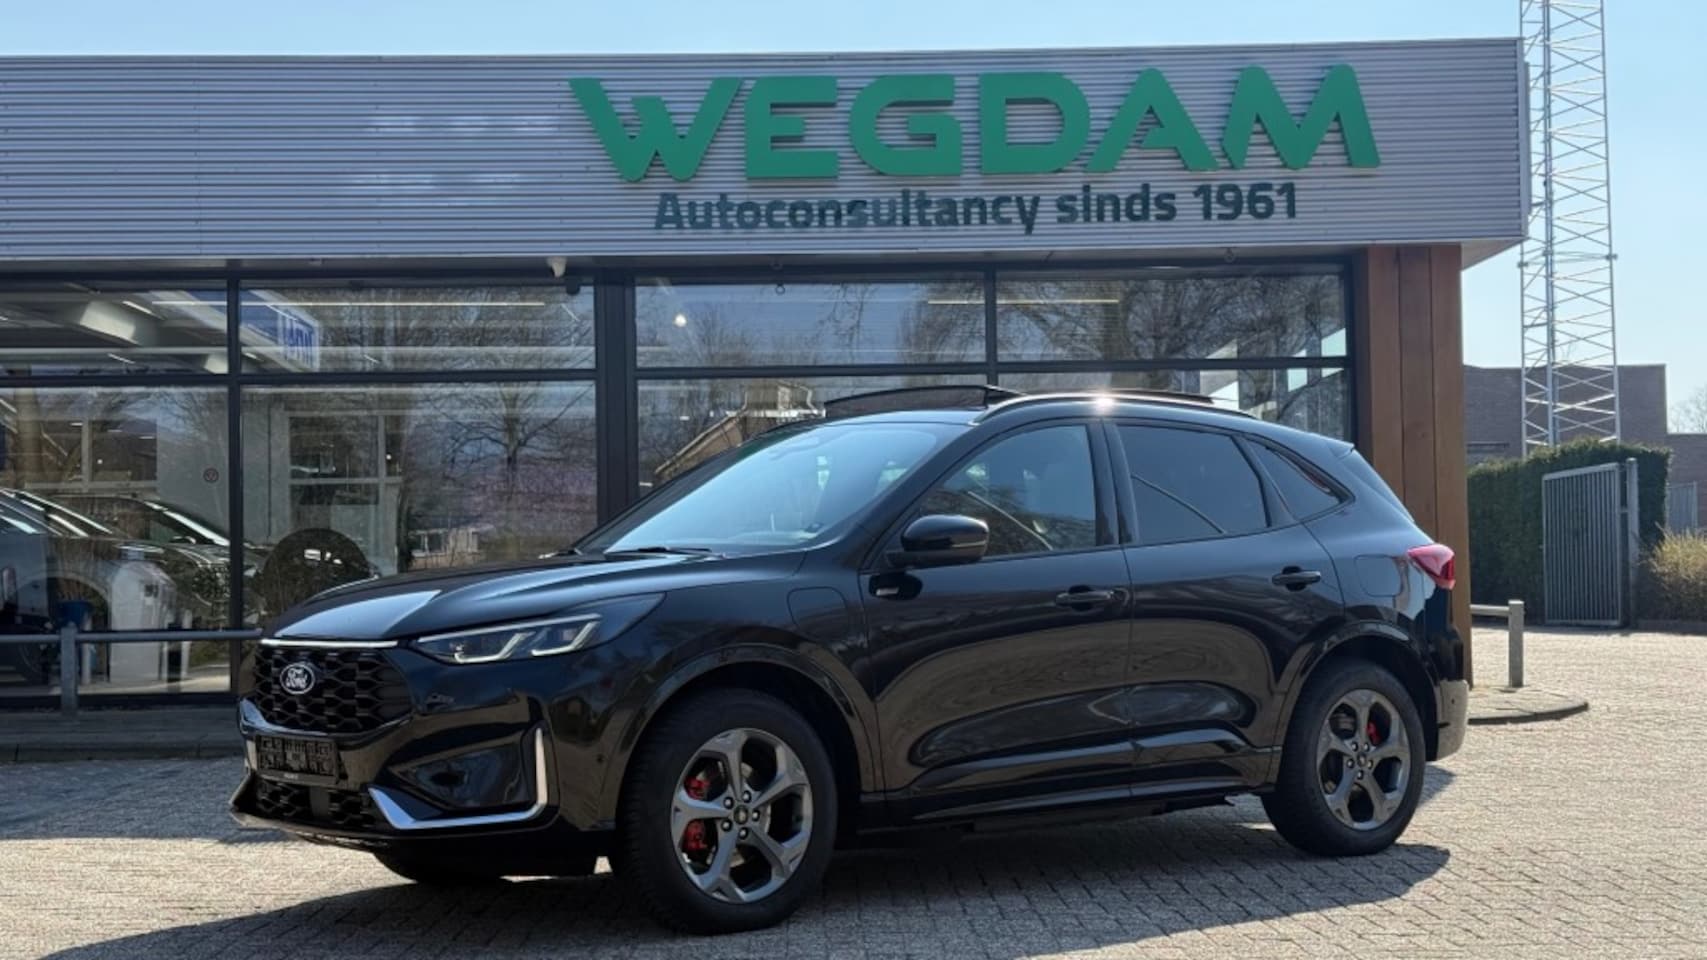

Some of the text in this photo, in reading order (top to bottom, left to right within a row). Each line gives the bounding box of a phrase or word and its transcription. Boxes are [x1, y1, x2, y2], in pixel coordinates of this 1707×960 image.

[569, 64, 1381, 182] WEGDAM
[655, 182, 1298, 235] Autoconsultancy sinds 1961
